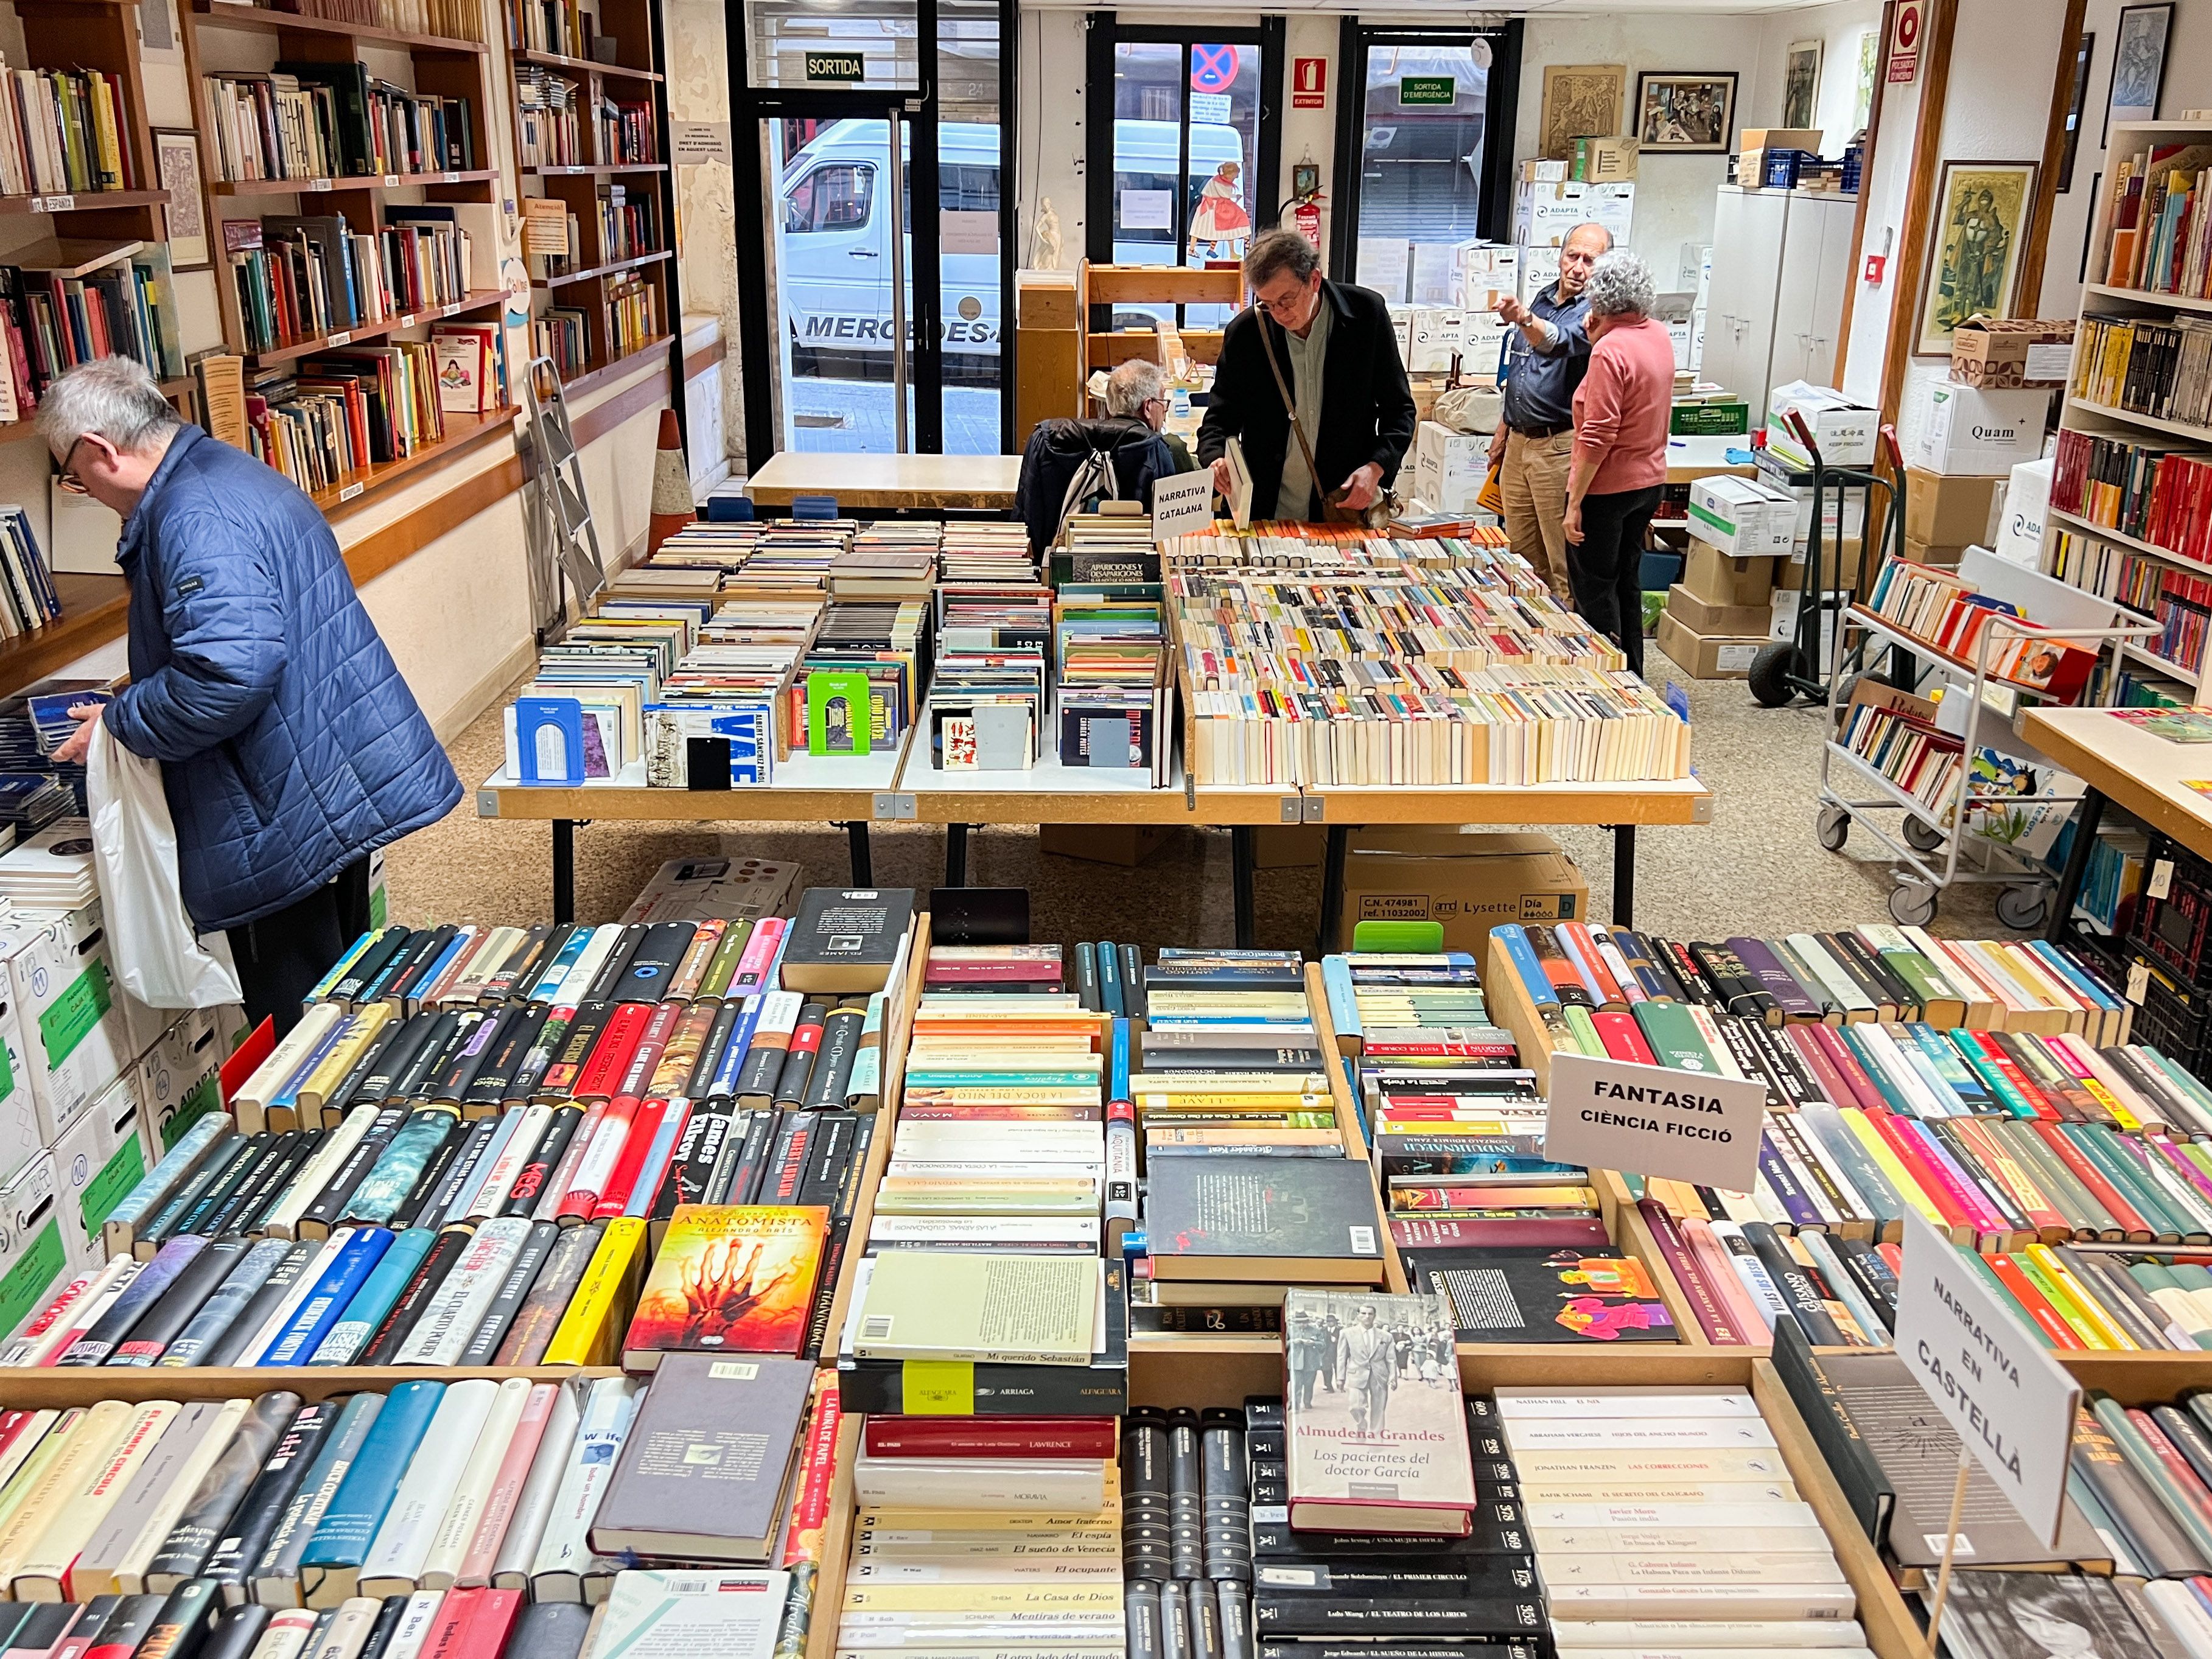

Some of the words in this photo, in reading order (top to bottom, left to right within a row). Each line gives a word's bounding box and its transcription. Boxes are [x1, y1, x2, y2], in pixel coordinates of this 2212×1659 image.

[809, 59, 861, 75] SORTIDA
[968, 82, 984, 96] 24
[1403, 89, 1450, 99] D'EMERGÈNCIA
[806, 316, 1000, 343] MERCES-
[1972, 425, 2014, 440] Quam
[1158, 486, 1206, 503] NARRATIVA
[1160, 503, 1203, 520] CATALANA
[2026, 520, 2040, 534] ADA
[757, 767, 766, 784] PIÑOL
[1464, 903, 1516, 913] Lysette
[1525, 899, 1542, 908] Día
[579, 1024, 596, 1034] EL
[561, 1033, 590, 1063] DESCENSO
[1594, 1081, 1724, 1115] FANTASIA
[2088, 1077, 2110, 1102] DUFF
[2104, 1095, 2123, 1116] THE
[1581, 1109, 1659, 1132] CIÈNCIA
[1666, 1123, 1732, 1143] FICCIÓ
[672, 1112, 709, 1162] Ellroy
[698, 1111, 732, 1164] James
[788, 1130, 808, 1162] ROBERT
[1112, 1134, 1123, 1174] AQUITANIA
[1404, 1143, 1515, 1153] ANDUIRNAECH
[74, 1162, 85, 1180] 10
[1766, 1157, 1783, 1178] Moix
[510, 1161, 547, 1200] MEG
[777, 1161, 799, 1200] LUDLUM
[1777, 1173, 1797, 1198] Terenci
[677, 1216, 812, 1226] ANATOMISTA
[464, 1232, 497, 1276] ARCHER
[830, 1242, 841, 1265] THOMAS
[824, 1264, 836, 1287] HARRIS
[452, 1290, 464, 1302] EL
[24, 1280, 88, 1338] GOMORRA
[433, 1298, 461, 1333] CUARTO
[809, 1290, 835, 1350] HANNIBAL
[1934, 1276, 2020, 1389] NARRATIVA
[416, 1329, 444, 1363] PODER
[1002, 1353, 1036, 1363] querido
[1040, 1353, 1085, 1363] Sebastián
[1962, 1347, 1983, 1383] EN
[826, 1398, 837, 1408] LA
[1917, 1339, 2023, 1486] CASTELLÀ
[821, 1410, 835, 1430] NIÑA
[819, 1431, 831, 1442] DE
[1296, 1426, 1376, 1439] Almudena
[1380, 1429, 1445, 1441] Grandes
[815, 1444, 829, 1467] PAPEL
[1314, 1449, 1337, 1461] Los
[1341, 1451, 1405, 1464] pacientes
[1410, 1453, 1430, 1464] del
[587, 1467, 598, 1482] Todo
[1325, 1464, 1370, 1476] doctor
[1374, 1466, 1419, 1478] García
[584, 1483, 592, 1492] un
[575, 1494, 588, 1520] hombre
[1087, 1531, 1111, 1540] espía
[1029, 1545, 1059, 1553] sueño
[1068, 1566, 1116, 1575] ocupante
[784, 1587, 810, 1647] Afrodita
